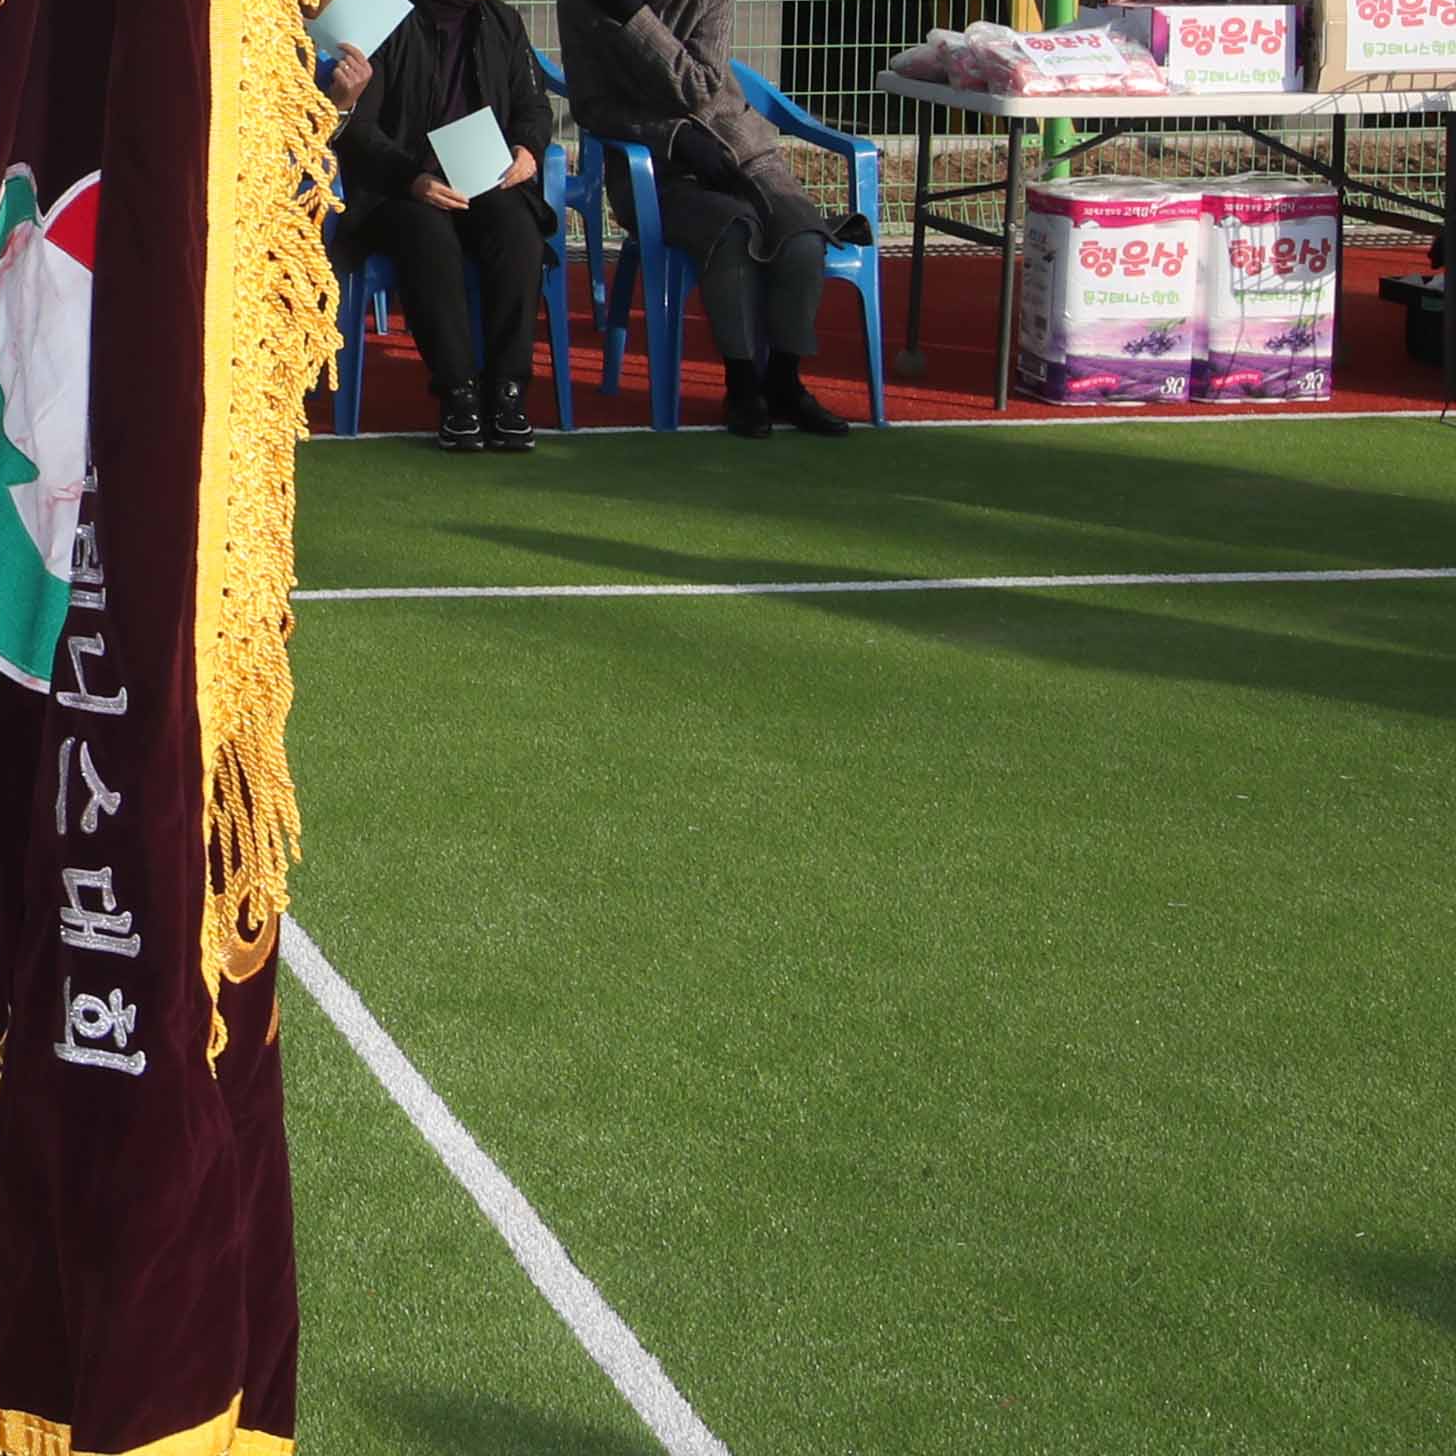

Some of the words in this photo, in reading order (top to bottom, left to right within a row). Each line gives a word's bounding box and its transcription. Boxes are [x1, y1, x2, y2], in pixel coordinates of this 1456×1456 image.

[1179, 17, 1288, 56] 행운상
[1078, 239, 1189, 278] 행운상
[1228, 236, 1332, 276] 행운상
[53, 464, 147, 1077] 테니스대회
